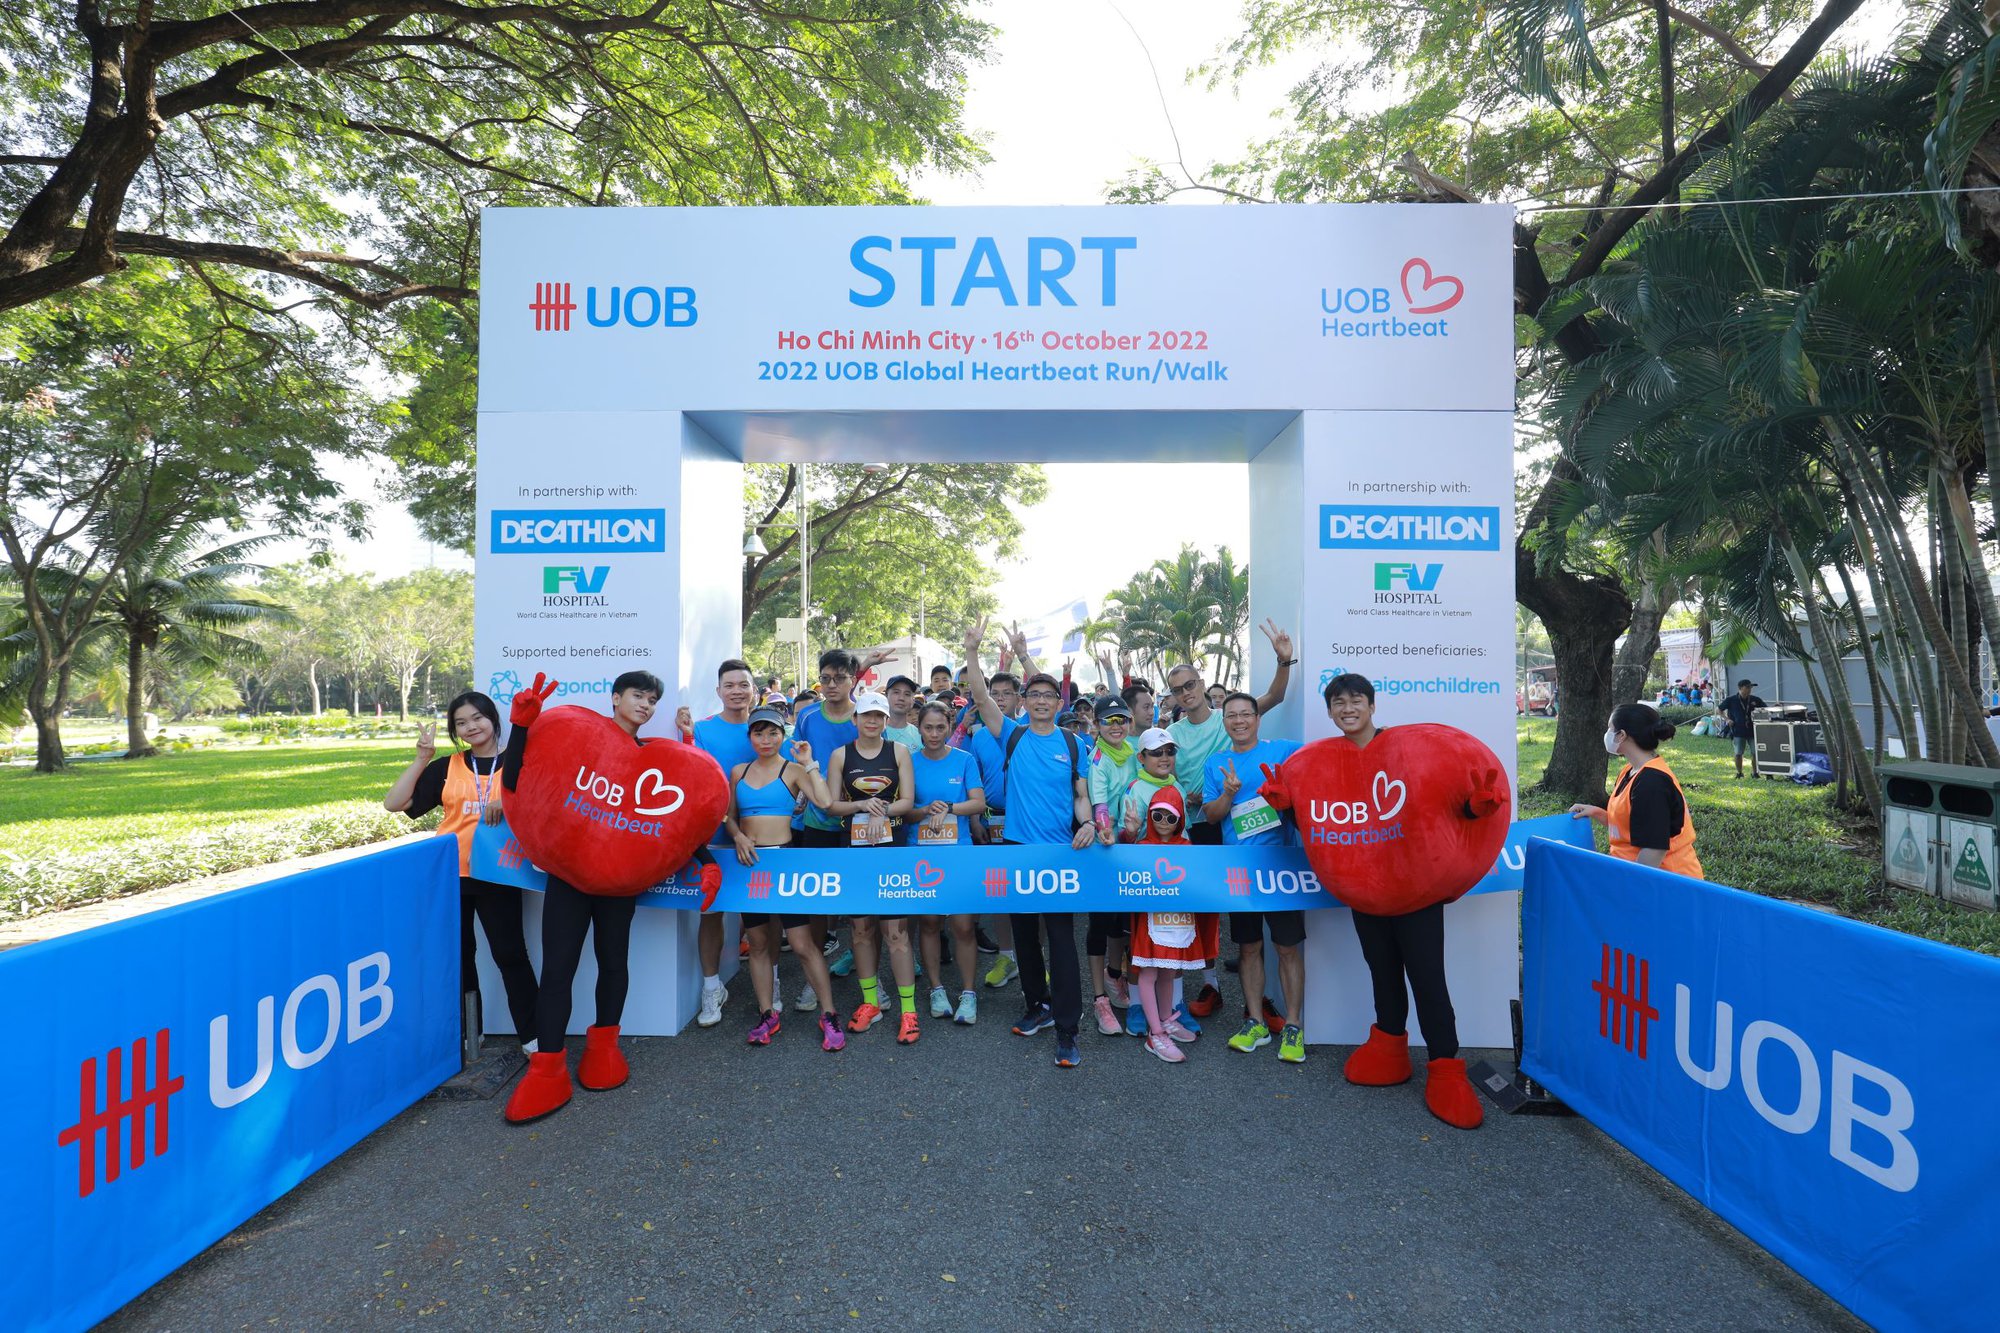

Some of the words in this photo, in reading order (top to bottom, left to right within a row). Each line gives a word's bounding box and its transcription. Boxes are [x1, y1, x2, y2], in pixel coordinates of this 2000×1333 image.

[849, 236, 1136, 307] START
[587, 287, 698, 327] UOB
[1322, 288, 1390, 313] UOB
[1323, 317, 1448, 336] Heartbeat
[779, 331, 810, 349] Ho
[818, 330, 854, 350] Chi
[862, 330, 920, 349] Minh
[928, 330, 975, 354] City
[993, 330, 1034, 350] 16th
[1042, 330, 1142, 350] October
[1148, 331, 1208, 350] 2022
[759, 362, 817, 380] 2022
[826, 362, 878, 380] UOB
[886, 361, 963, 380] Global
[972, 361, 1098, 380] Heartbeat
[1106, 359, 1228, 383] Run/Walk
[519, 487, 529, 496] In
[534, 485, 604, 499] partnership
[608, 485, 637, 496] with:
[1349, 481, 1359, 491] In
[1364, 481, 1436, 494] partnership
[1441, 482, 1470, 492] with:
[501, 519, 655, 543] DECATHLON
[1330, 515, 1489, 540] DECATHLON
[543, 566, 610, 593] FV
[1374, 563, 1443, 591] FV
[544, 596, 608, 606] HOSPITAL
[1375, 593, 1442, 604] HOSPITAL
[503, 646, 565, 659] Supported
[571, 645, 651, 656] beneficiaries:
[1332, 643, 1398, 656] Supported
[1403, 644, 1486, 656] beneficiaries:
[1374, 677, 1500, 696] aigonchildren
[575, 766, 625, 807] UOB
[564, 791, 664, 837] Heartbeat
[1240, 812, 1269, 830] 5031
[1310, 800, 1368, 823] UOB
[1310, 822, 1404, 845] Heartbeat
[778, 873, 840, 896] UOB
[879, 874, 910, 887] UOB
[1016, 869, 1080, 894] UOB
[1119, 872, 1151, 884] UOB
[1119, 884, 1179, 895] Heartbeat
[1256, 869, 1321, 894] UOB
[648, 885, 699, 896] eartbeat
[879, 888, 936, 898] Heartbeat
[1157, 914, 1192, 924] 10043
[209, 952, 393, 1108] UOB
[1674, 983, 1919, 1194] UOB
